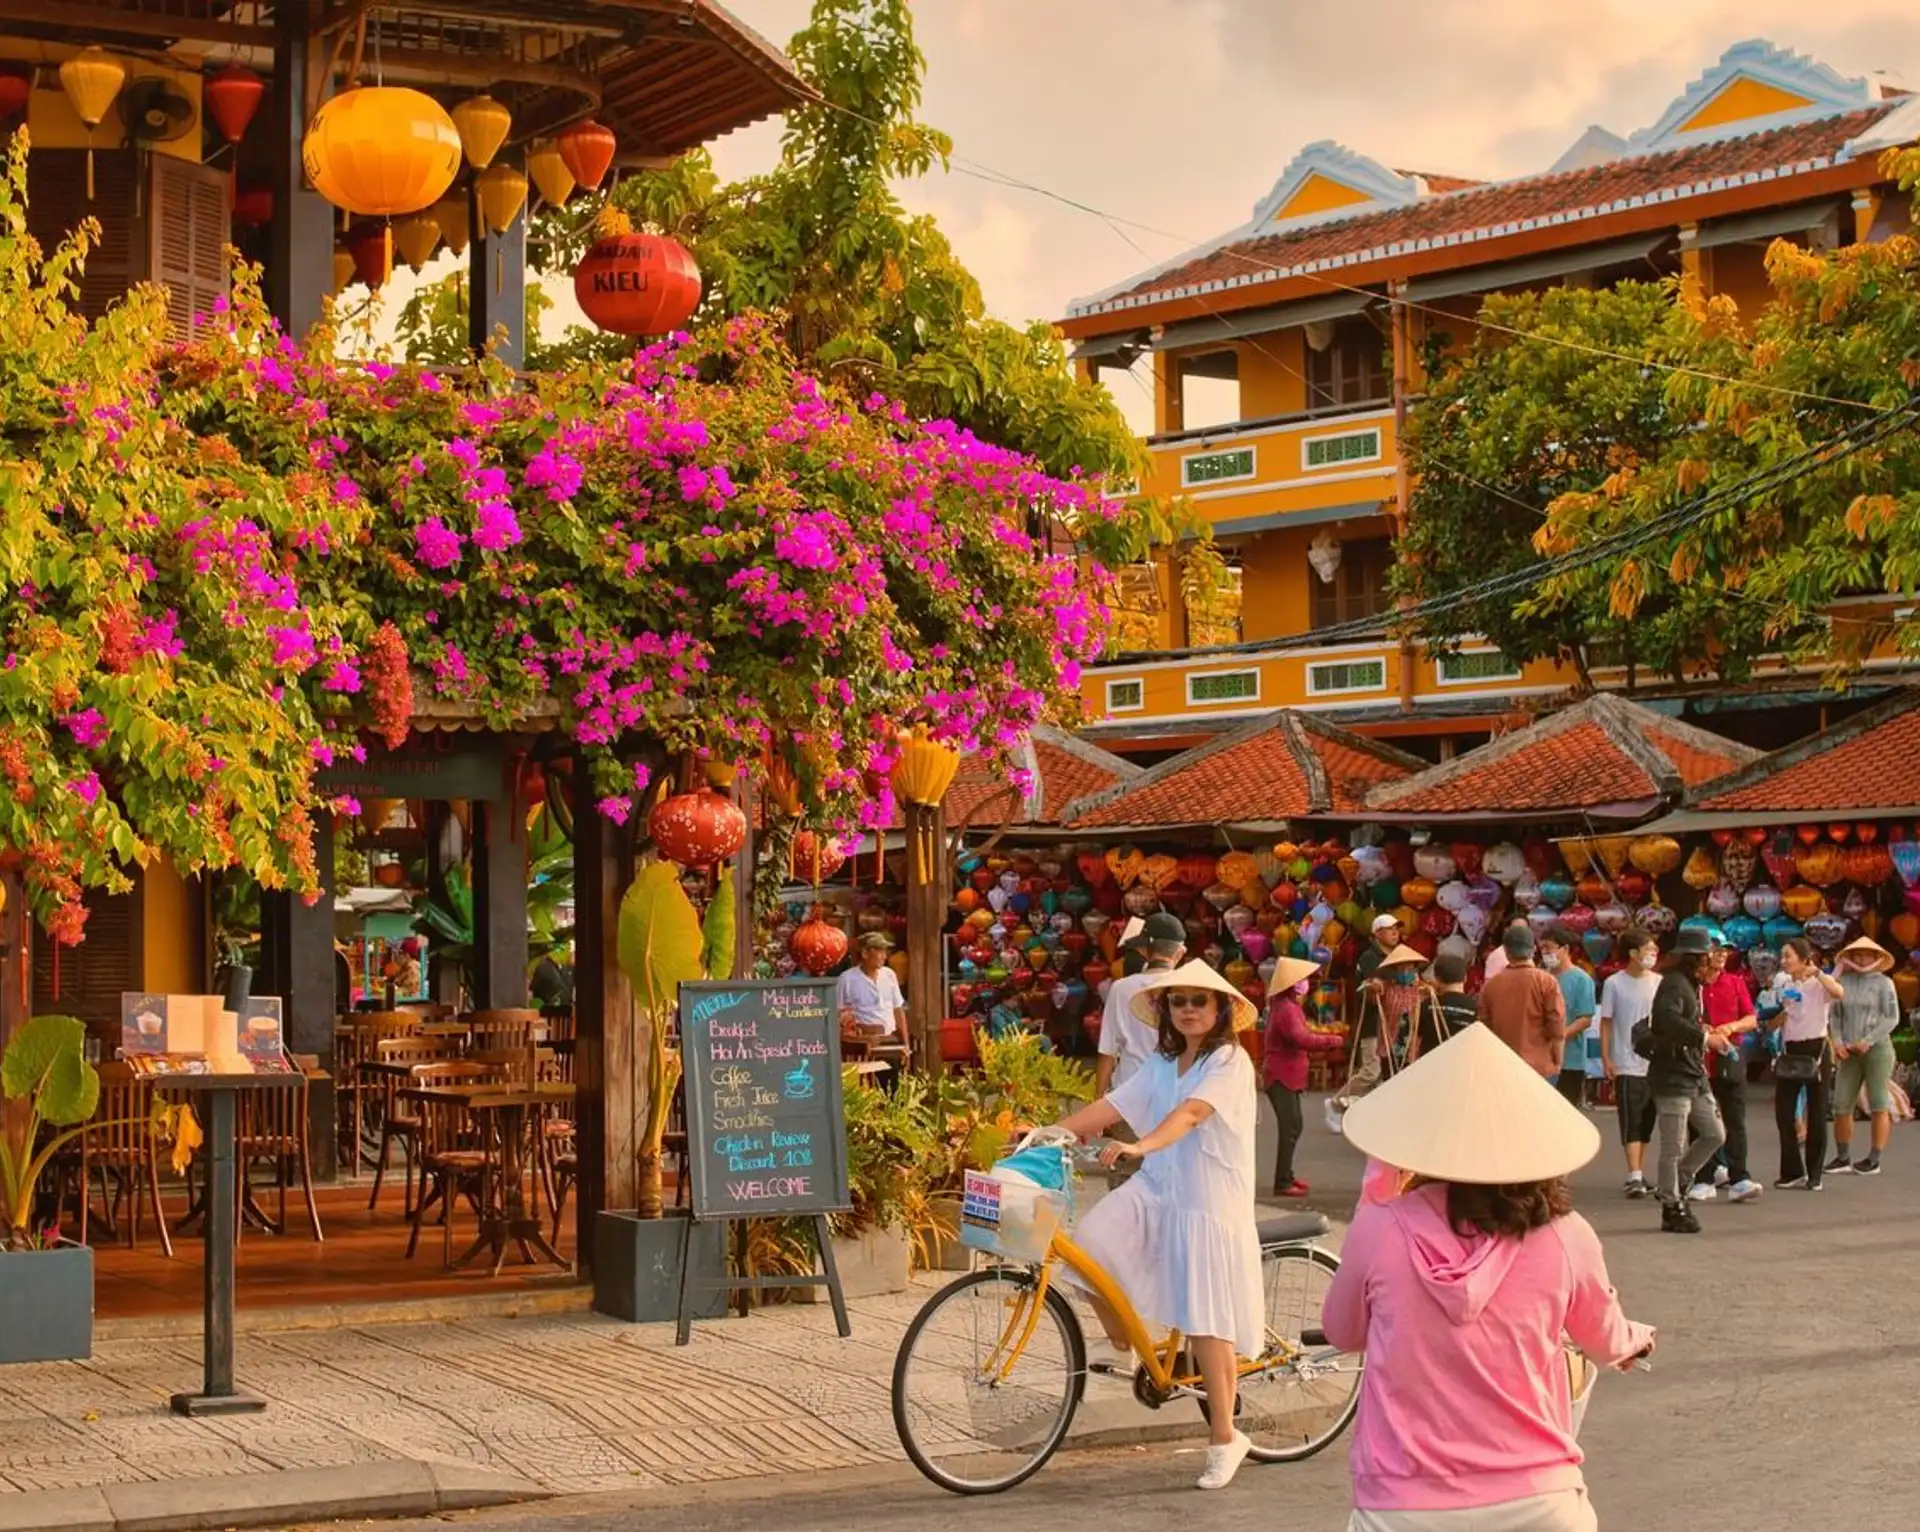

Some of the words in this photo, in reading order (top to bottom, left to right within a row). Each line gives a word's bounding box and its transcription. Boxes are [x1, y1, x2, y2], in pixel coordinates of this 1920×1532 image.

[593, 271, 649, 293] KIEU
[711, 1065, 753, 1091] Coffee
[714, 1088, 746, 1109] Fresh
[750, 1086, 780, 1106] Juice
[726, 1176, 813, 1201] WELCOME
